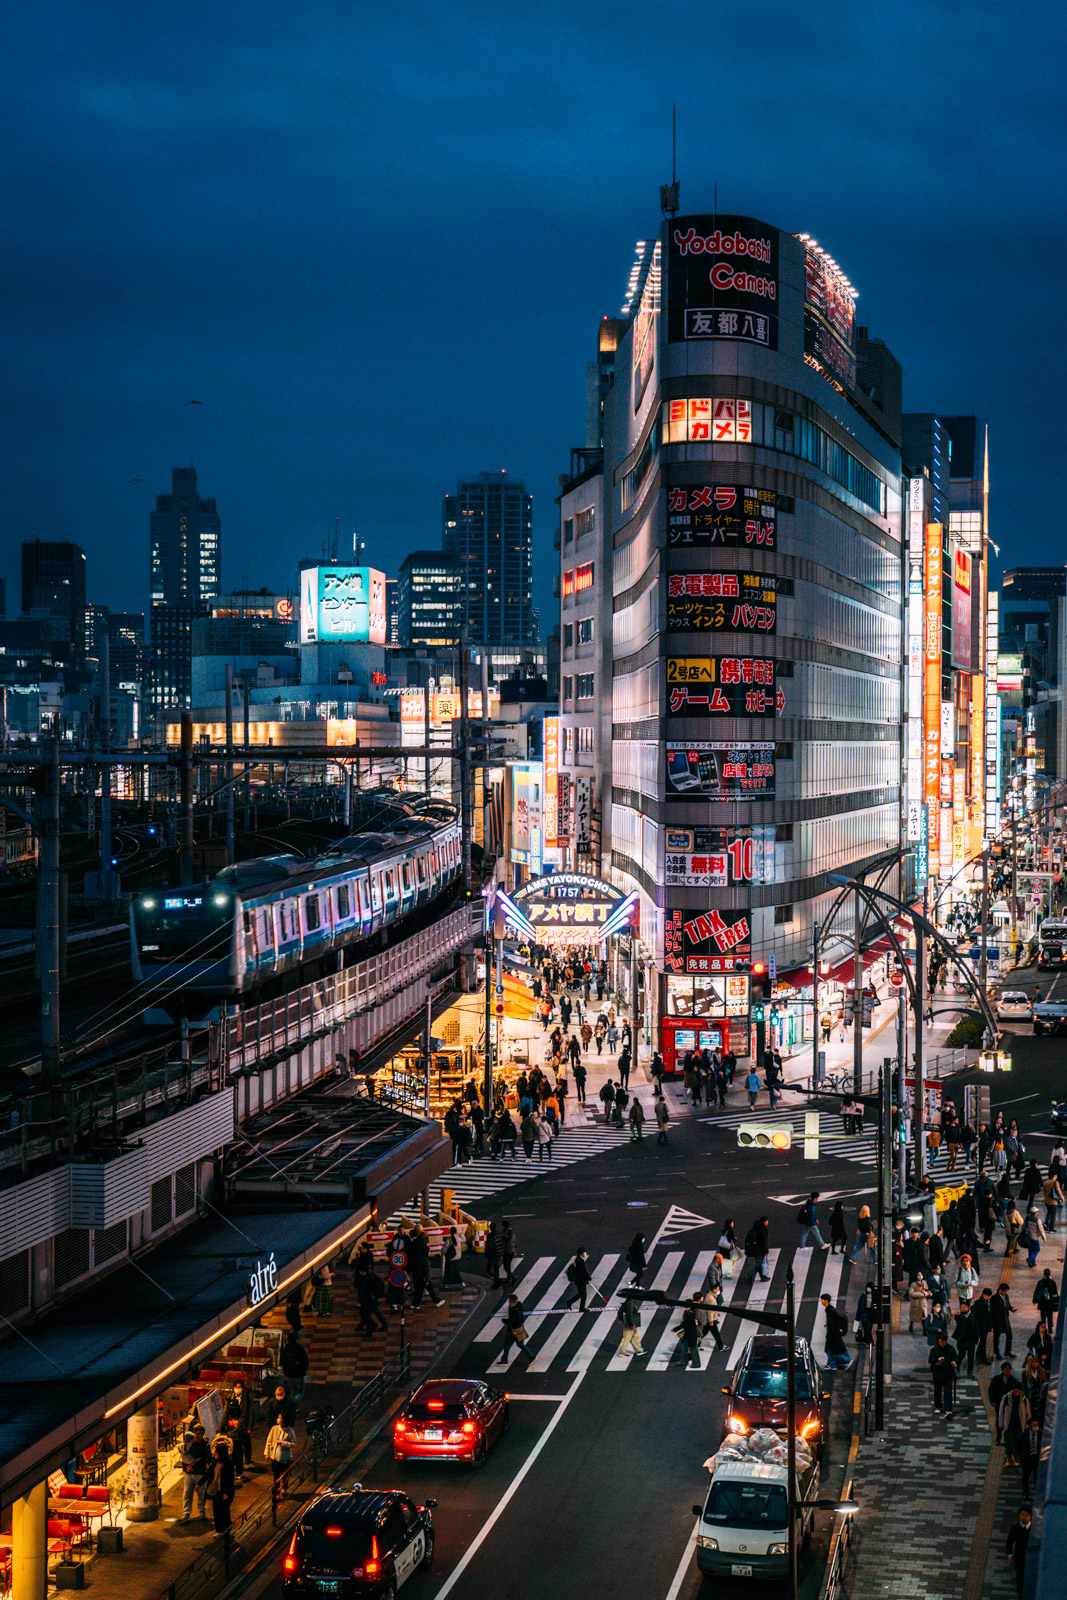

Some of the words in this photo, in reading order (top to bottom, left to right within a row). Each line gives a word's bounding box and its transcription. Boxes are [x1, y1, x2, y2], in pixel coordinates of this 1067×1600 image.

[674, 228, 770, 264] Yodobashi
[709, 262, 776, 301] Camera
[692, 311, 766, 341] 友都八喜
[671, 400, 750, 420] ヨドバシ
[691, 422, 751, 440] カメラ
[668, 486, 737, 512] カメラ
[694, 514, 741, 526] ドライヤー
[670, 526, 739, 543] シェーバー
[745, 519, 775, 546] テレビ
[929, 546, 940, 599] カラオケ
[668, 574, 740, 597] 家電製品
[320, 597, 367, 611] センター
[668, 602, 726, 616] スーツケース
[668, 618, 690, 628] マウス
[693, 615, 725, 628] インク
[731, 603, 776, 631] パソコン
[668, 660, 712, 681] 2号店へ
[720, 658, 774, 686] 携帯電話
[438, 700, 453, 715] 薬
[669, 687, 731, 713] ゲーム
[745, 689, 774, 713] ホビー
[546, 726, 558, 777] カラオケ
[927, 730, 939, 783] カラオケ
[975, 752, 983, 803] エスパス
[579, 792, 588, 842] ルノアール
[666, 855, 687, 865] 入会金
[666, 865, 687, 875] 年会費
[691, 855, 725, 875] 無料
[526, 874, 609, 894] AMEYAYOKOCHO
[557, 887, 579, 897] 1757
[528, 903, 613, 922] アメヤ横丁
[665, 920, 673, 952] カメラ
[673, 910, 683, 952] ヨドバシ
[684, 909, 727, 945] TAX
[714, 917, 750, 953] FREE
[393, 1255, 404, 1264] 30
[250, 1252, 278, 1304] atré
